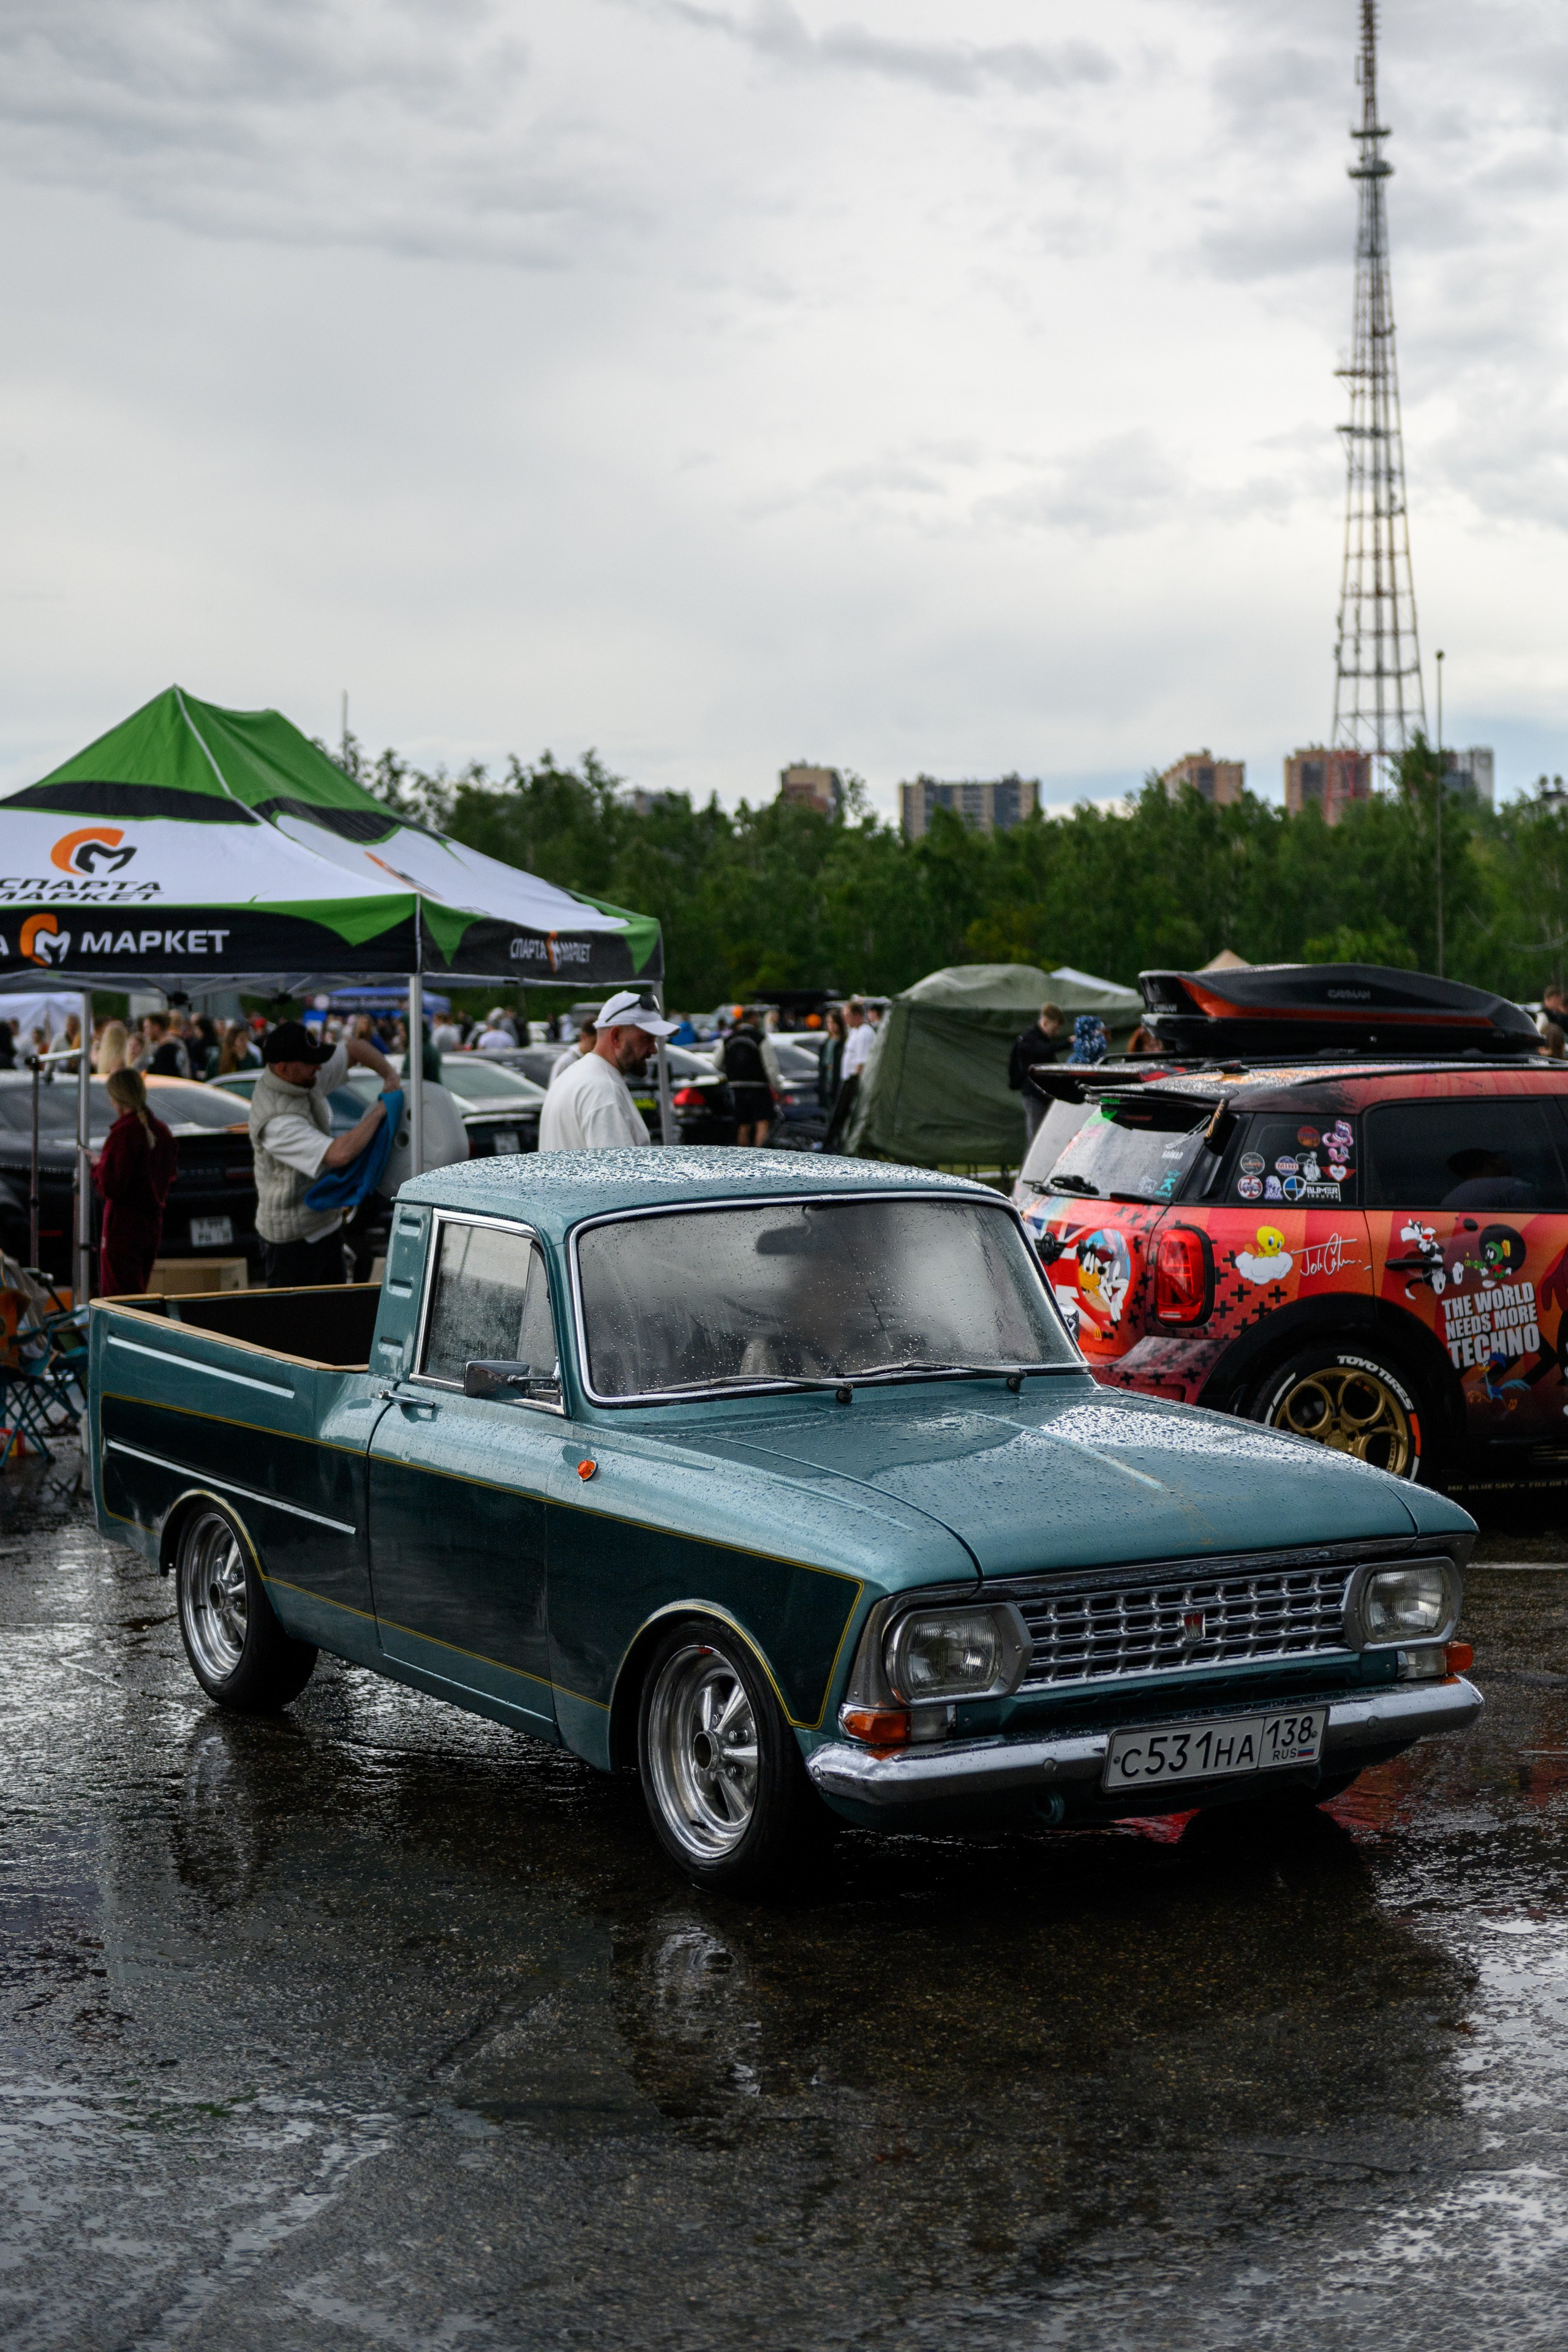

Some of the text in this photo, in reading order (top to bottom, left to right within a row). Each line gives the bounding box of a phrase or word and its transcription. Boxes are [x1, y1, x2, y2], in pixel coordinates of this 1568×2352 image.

[0, 878, 160, 891] СПАРТА
[80, 929, 230, 954] МАРКЕТ
[510, 938, 591, 963] СПАРТА МАРКЕТ
[1442, 1282, 1535, 1321] THE WORLD
[1445, 1303, 1538, 1340] NEEDS MORE
[1447, 1323, 1540, 1370] TECHNO
[1337, 1355, 1414, 1410] TOYO TIRES
[1120, 1716, 1314, 1777] С531НА 138
[1273, 1747, 1297, 1762] RUS
